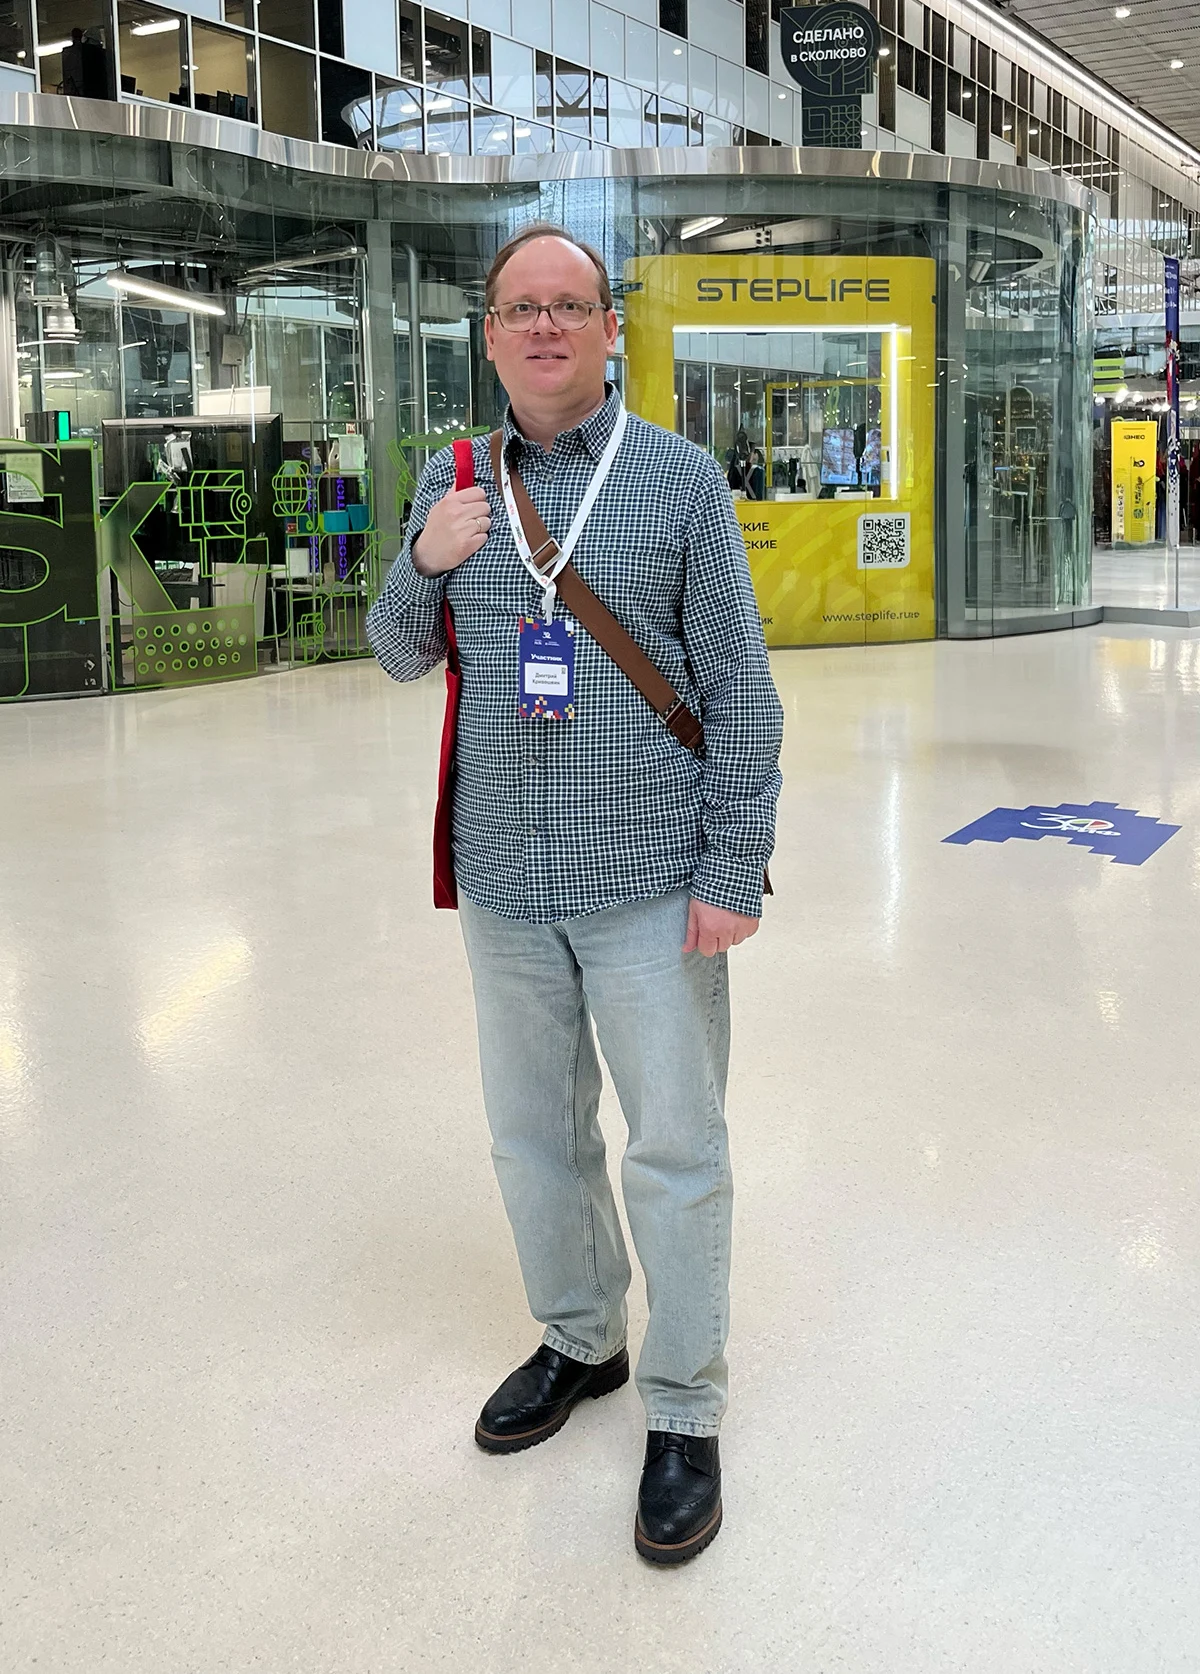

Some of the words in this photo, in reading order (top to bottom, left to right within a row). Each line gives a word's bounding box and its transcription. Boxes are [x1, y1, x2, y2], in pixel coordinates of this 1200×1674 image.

[793, 26, 864, 44] СДЕЛАНО
[790, 55, 798, 63] в
[799, 47, 867, 62] СКОЛКОВО
[697, 278, 890, 302] STEPLIFE
